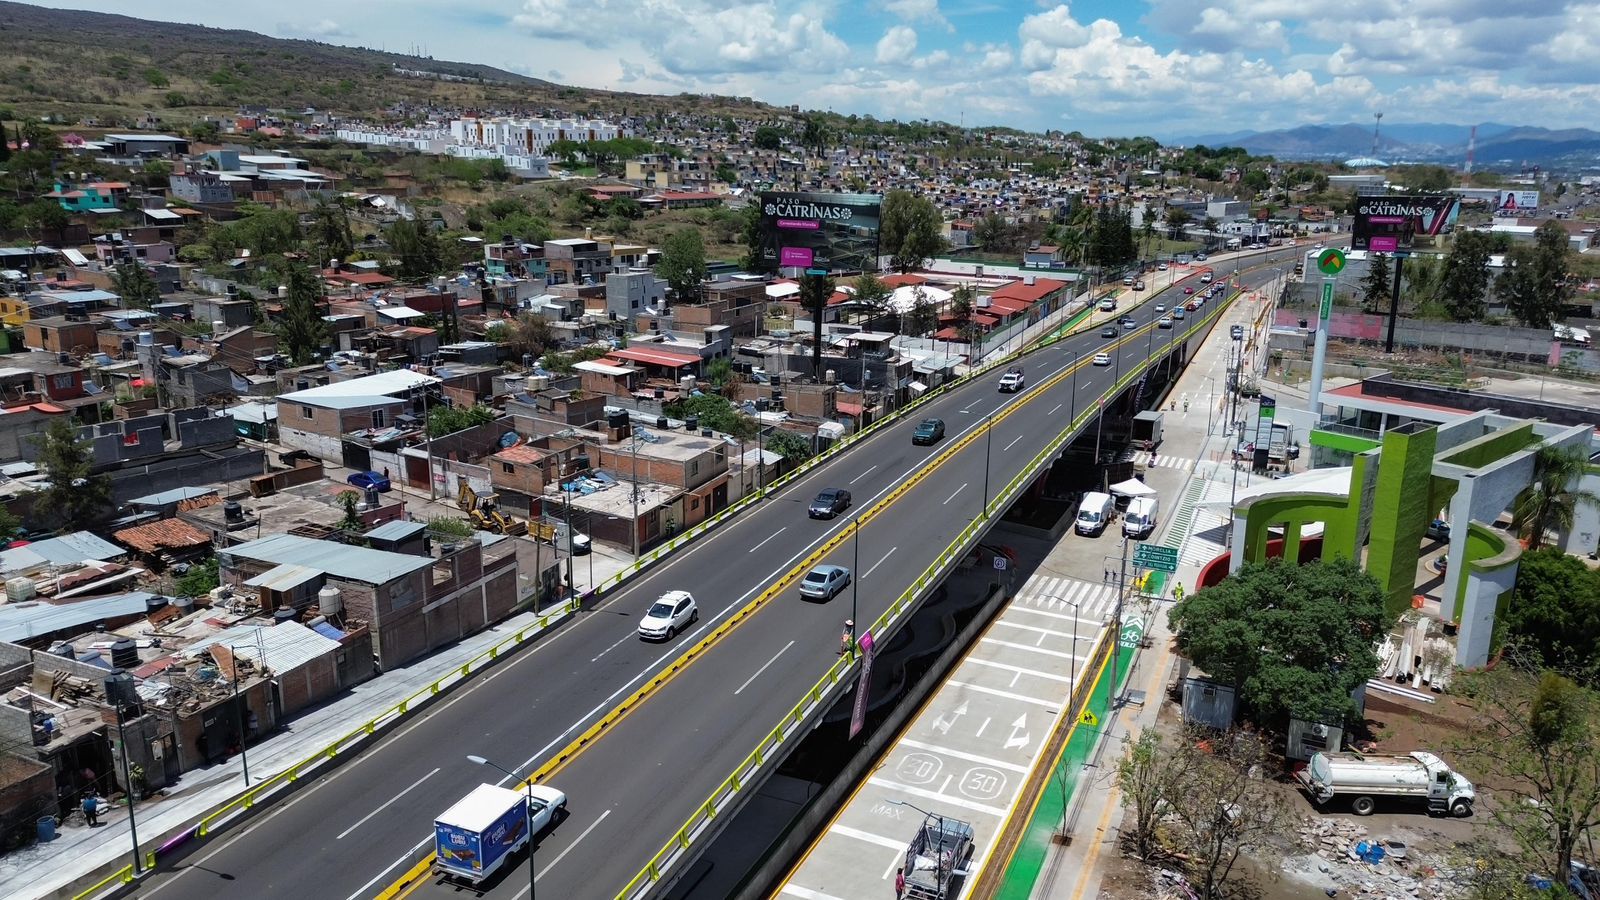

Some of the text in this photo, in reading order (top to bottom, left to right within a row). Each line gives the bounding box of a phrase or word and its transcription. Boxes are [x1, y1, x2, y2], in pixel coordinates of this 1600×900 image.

[776, 203, 841, 220] CATRINAS
[1368, 204, 1423, 216] CATRINAS
[968, 773, 998, 793] 30
[870, 803, 904, 820] MAX
